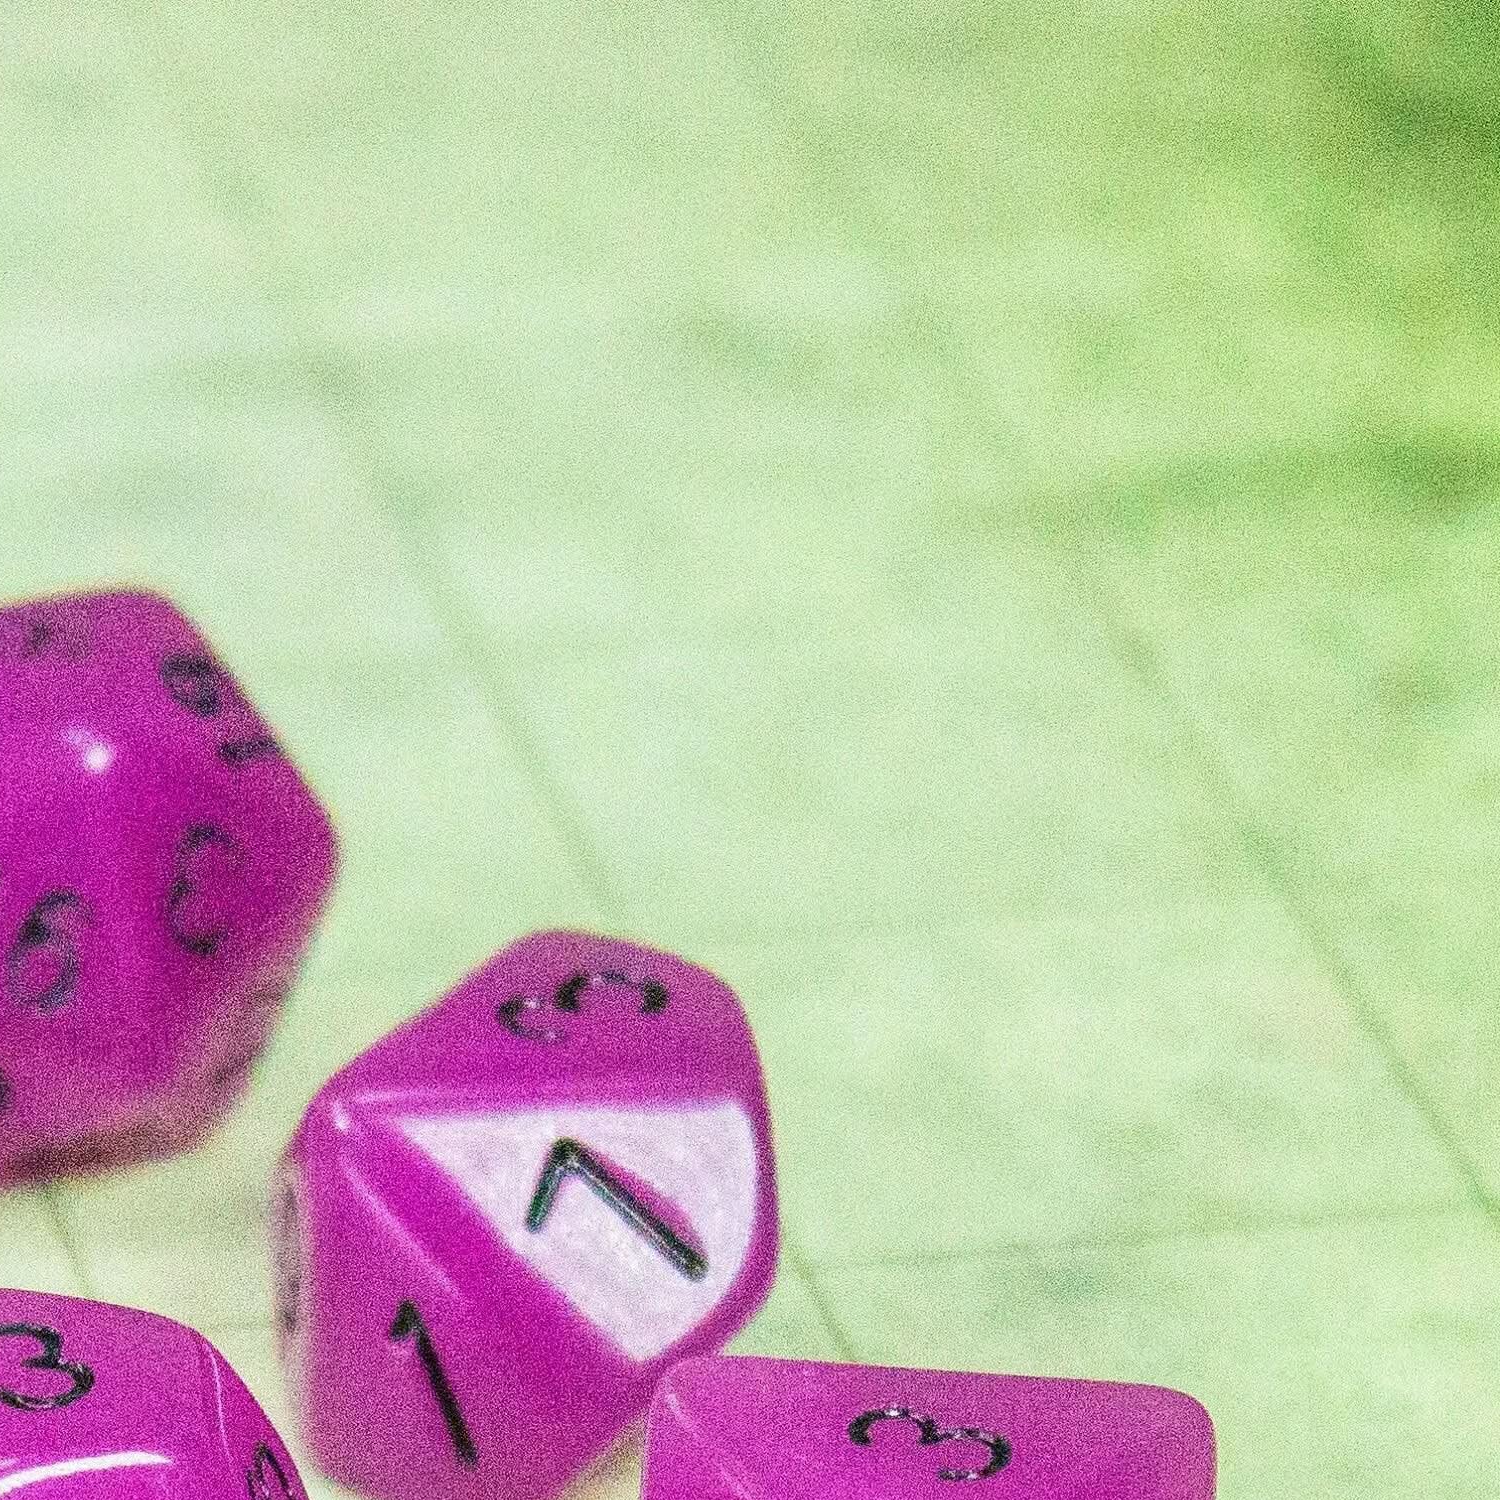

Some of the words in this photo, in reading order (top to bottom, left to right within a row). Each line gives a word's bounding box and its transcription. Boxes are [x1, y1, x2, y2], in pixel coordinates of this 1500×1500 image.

[526, 1136, 710, 1282] 7
[388, 1300, 480, 1475] 1
[846, 1404, 1014, 1484] 3
